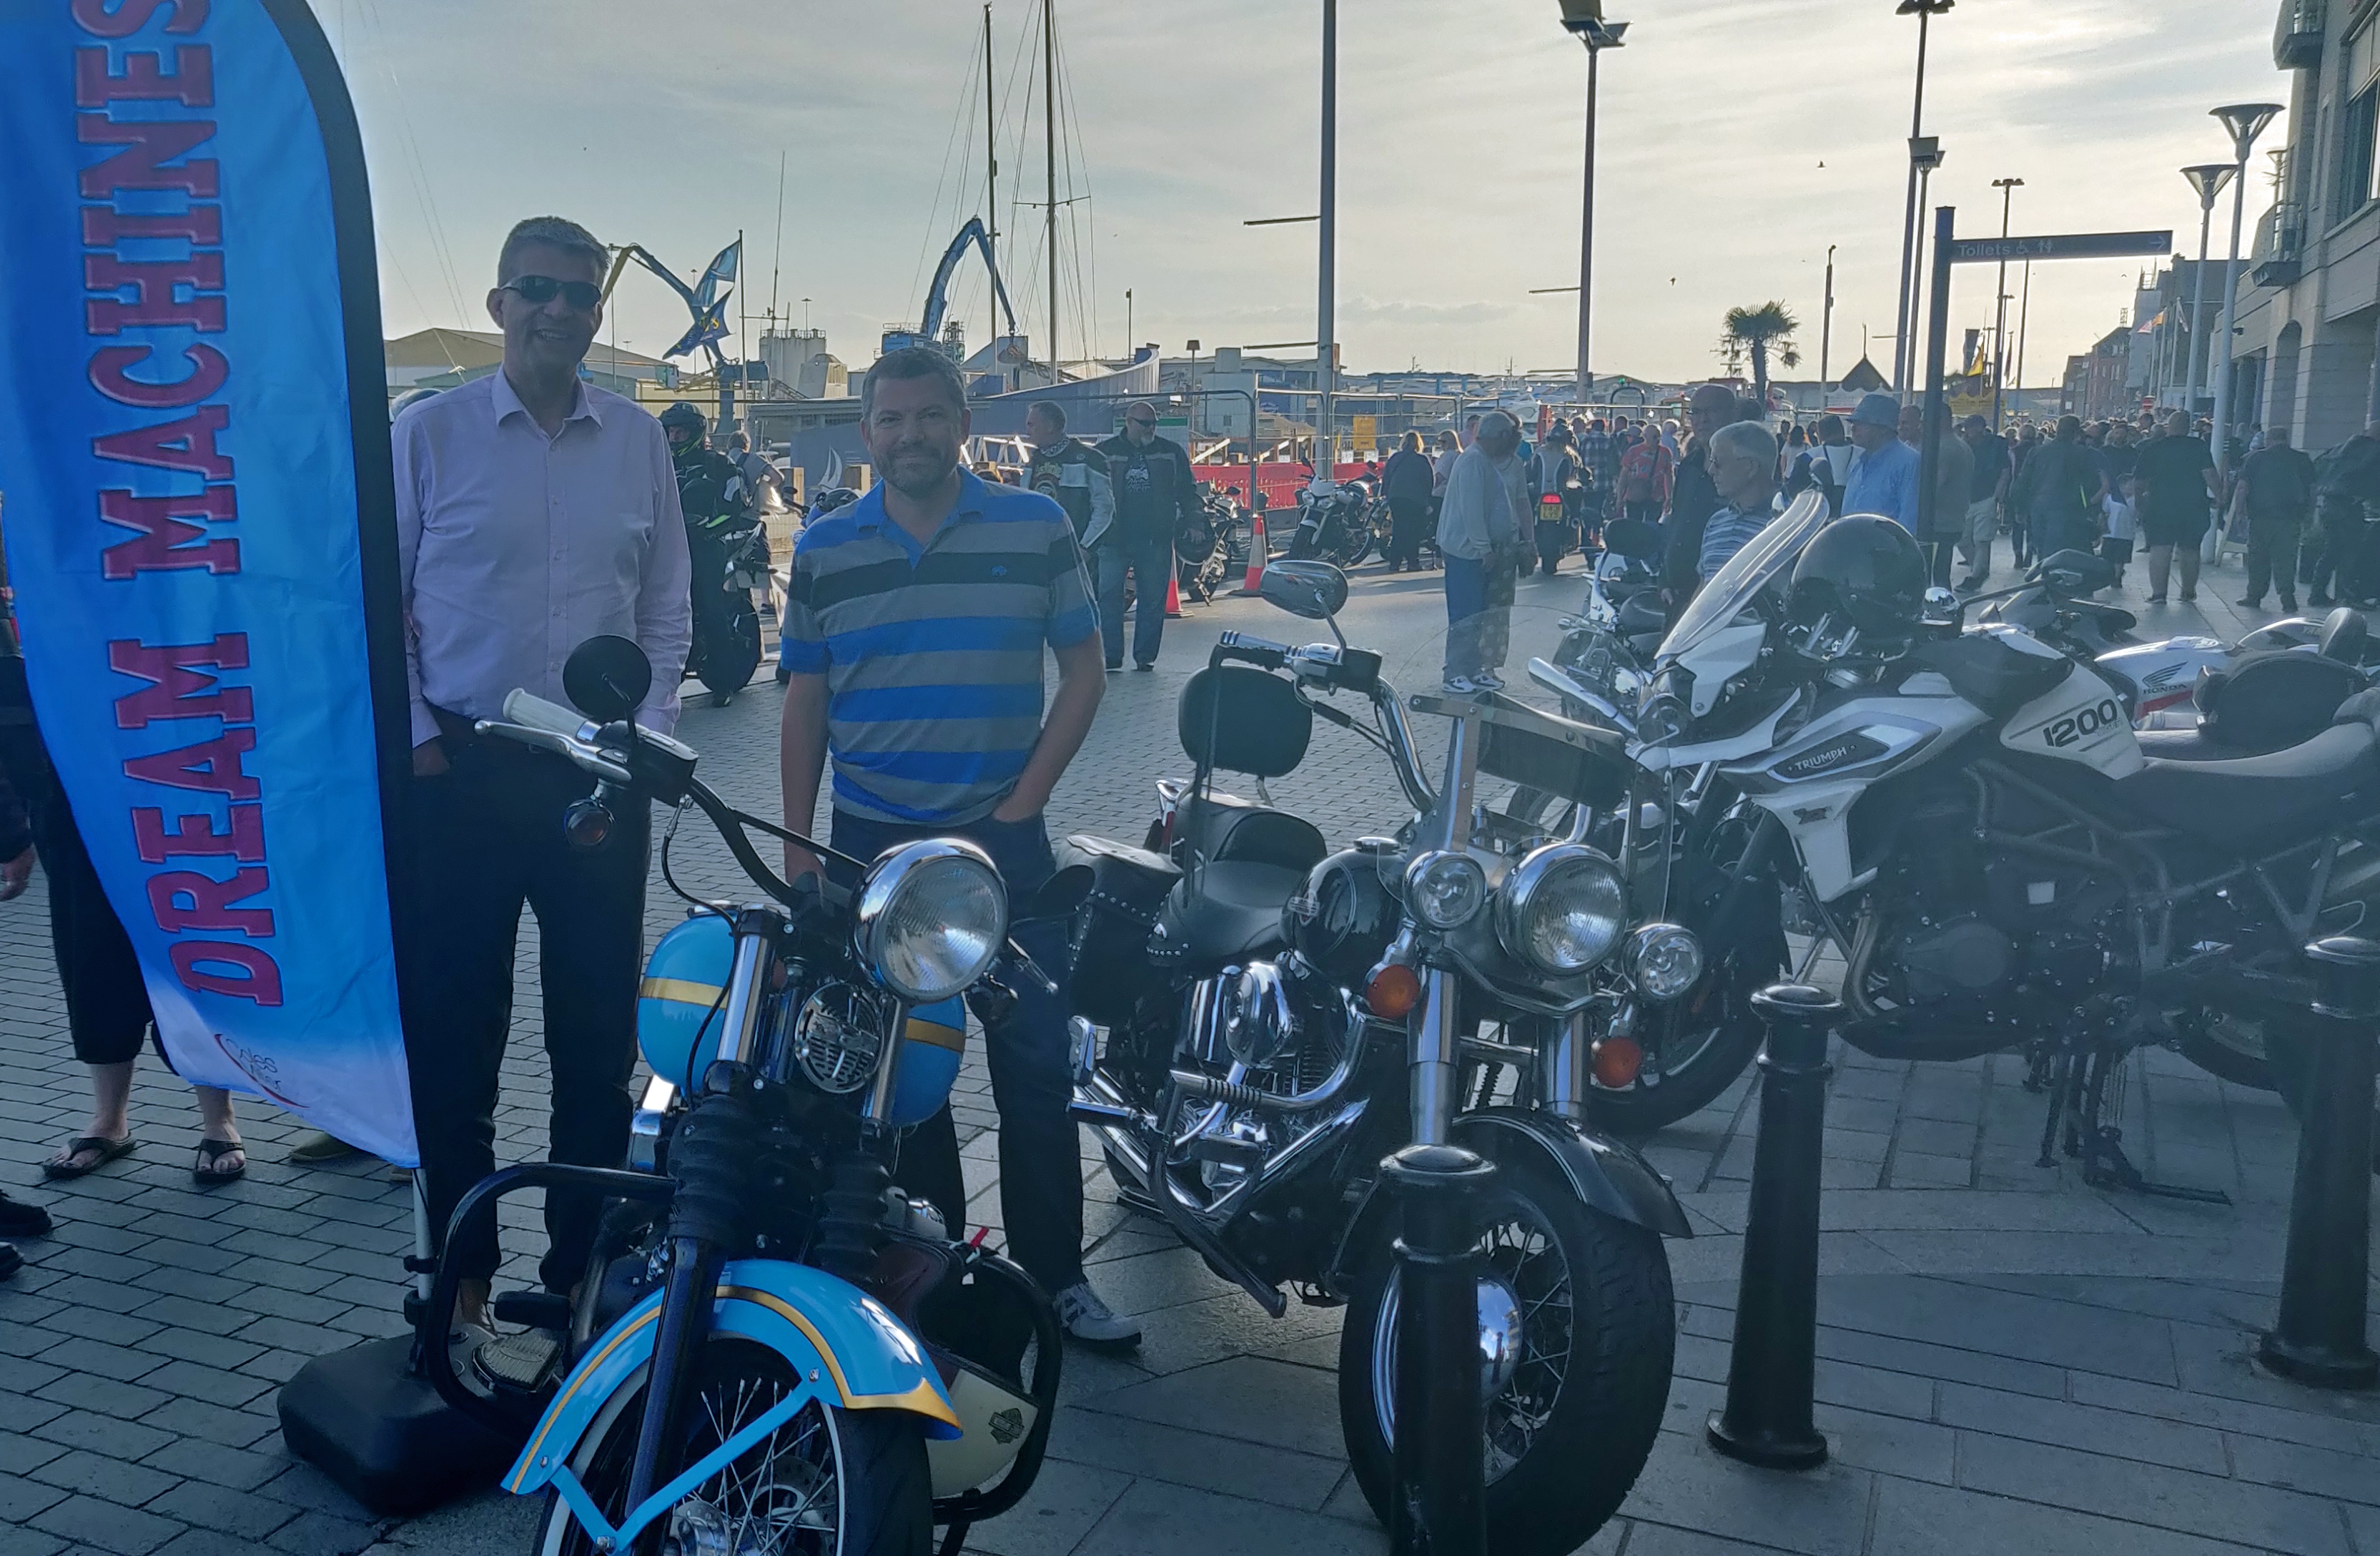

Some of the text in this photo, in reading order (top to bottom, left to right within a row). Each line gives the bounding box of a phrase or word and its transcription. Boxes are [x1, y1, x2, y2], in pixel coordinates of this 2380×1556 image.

[1957, 243, 2010, 257] Toilets
[72, 0, 284, 1007] DREAM MACHINES
[2143, 683, 2187, 695] HONDA
[2043, 699, 2118, 747] 1200
[1794, 746, 1847, 771] TRIUMPH
